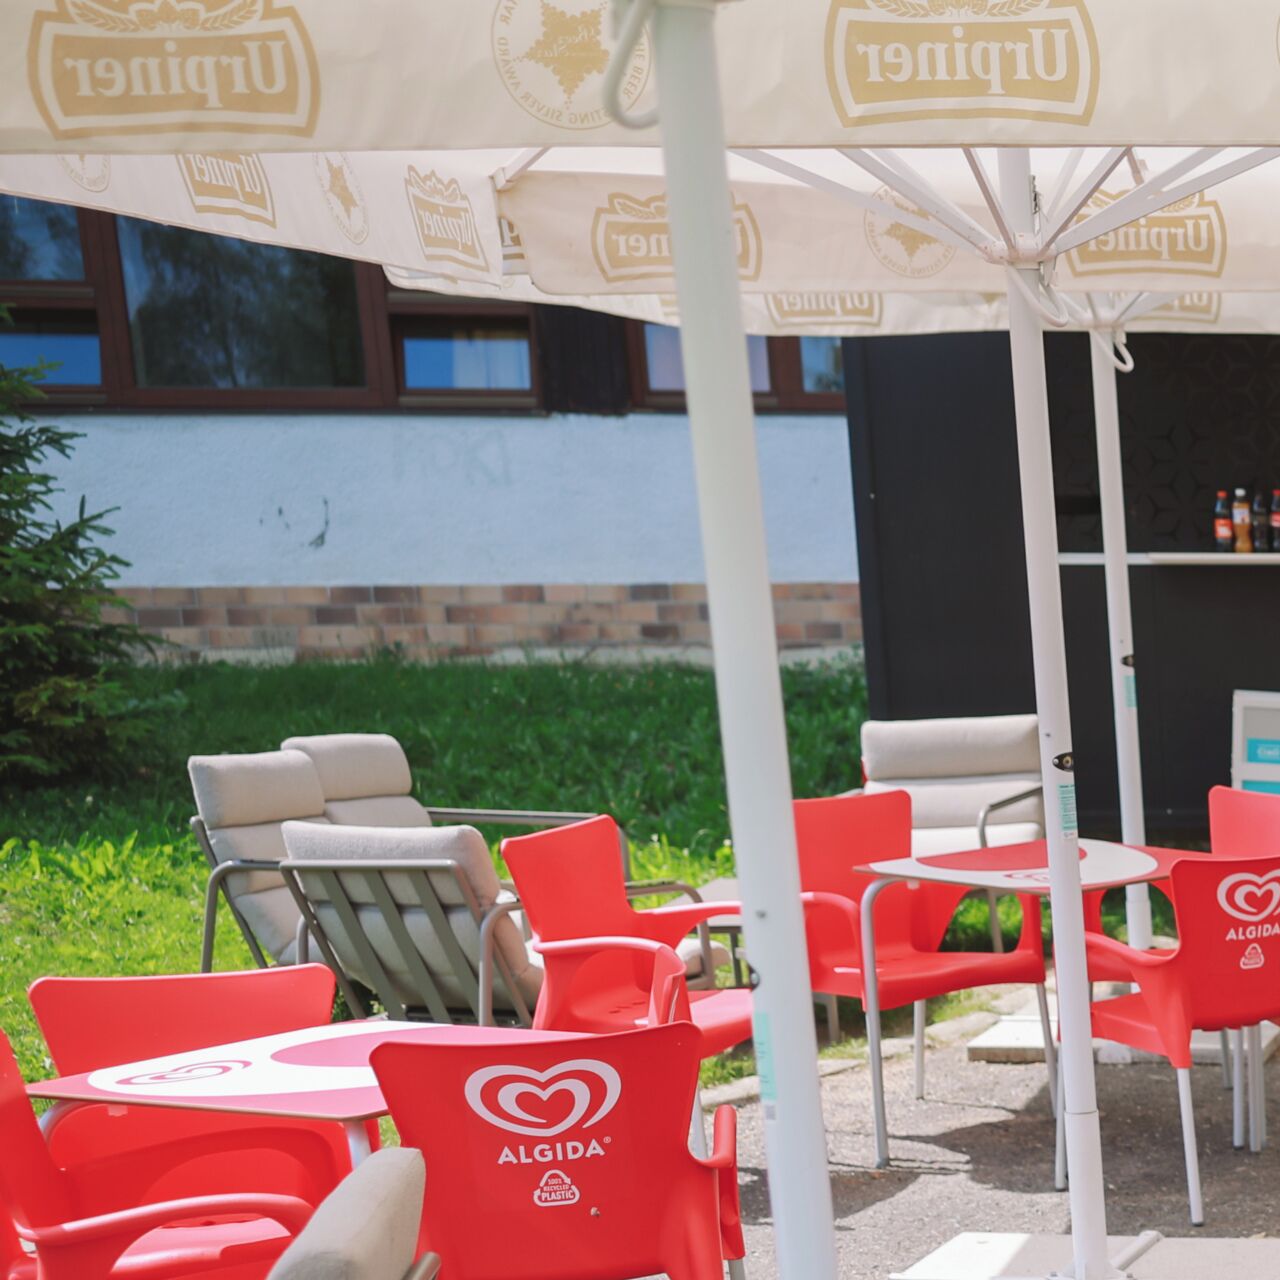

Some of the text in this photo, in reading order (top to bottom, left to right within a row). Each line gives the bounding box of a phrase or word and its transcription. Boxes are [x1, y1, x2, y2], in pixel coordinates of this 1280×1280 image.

[1225, 922, 1280, 941] ALGIDA
[497, 1138, 606, 1165] ALGIDA
[541, 1190, 574, 1201] PLASTIC
